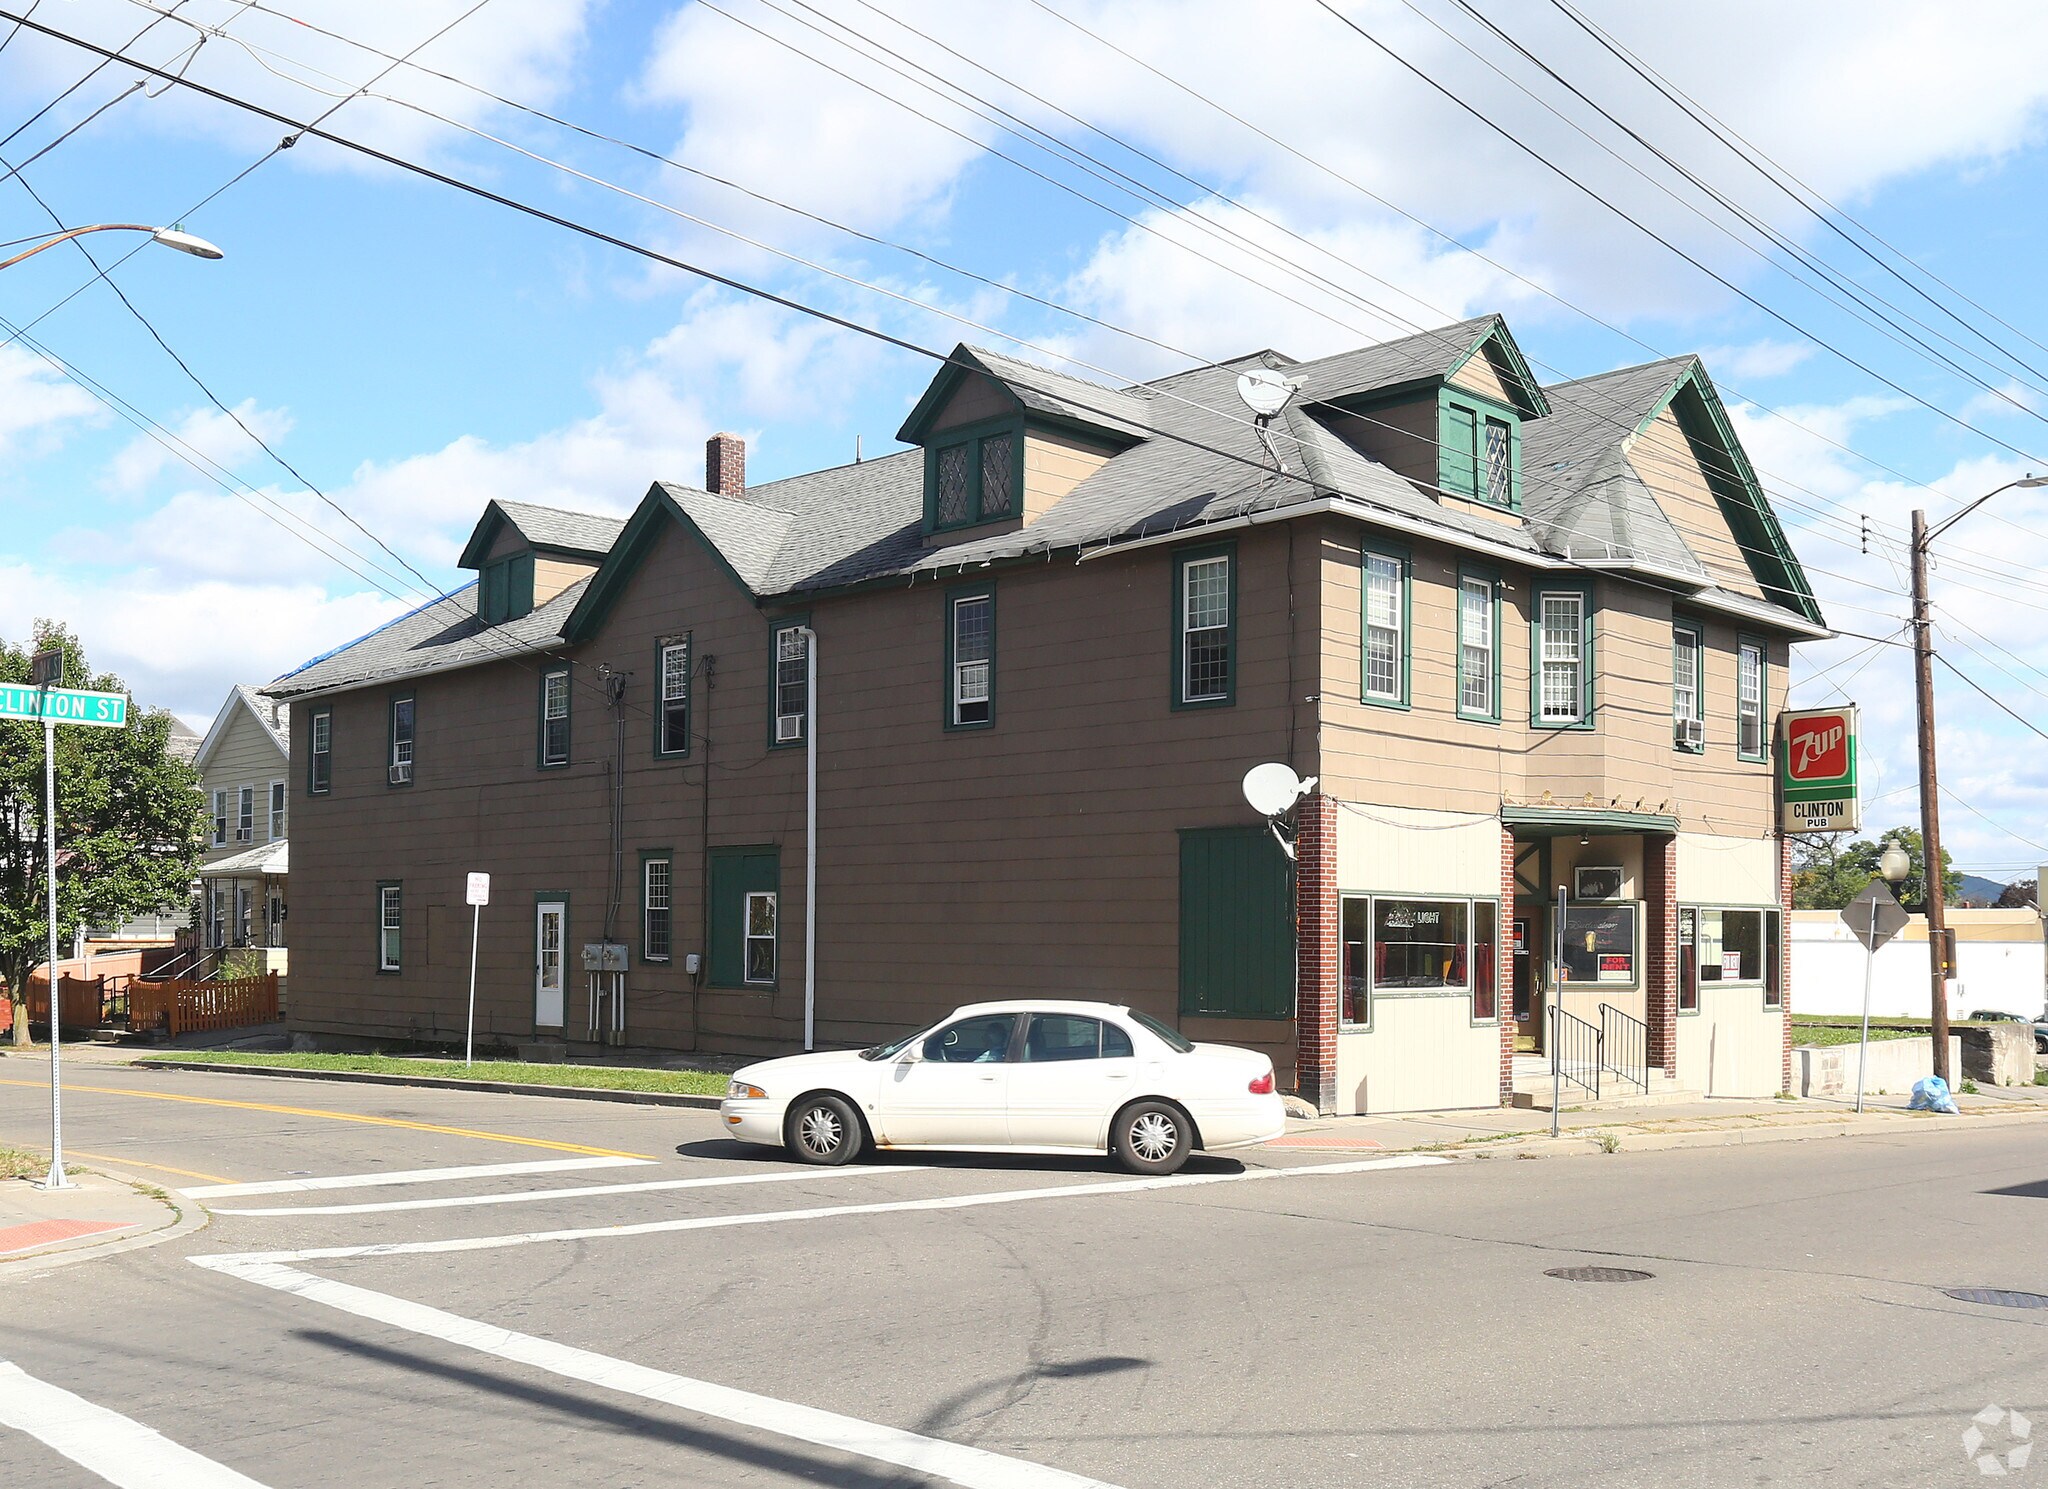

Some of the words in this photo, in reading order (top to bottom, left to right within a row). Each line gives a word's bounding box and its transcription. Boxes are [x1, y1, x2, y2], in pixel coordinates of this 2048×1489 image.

[96, 699, 122, 721] ST
[1792, 725, 1843, 774] 7UP
[1793, 801, 1844, 818] CLINTON
[1807, 818, 1827, 827] PUB
[1417, 911, 1440, 924] LIGHT
